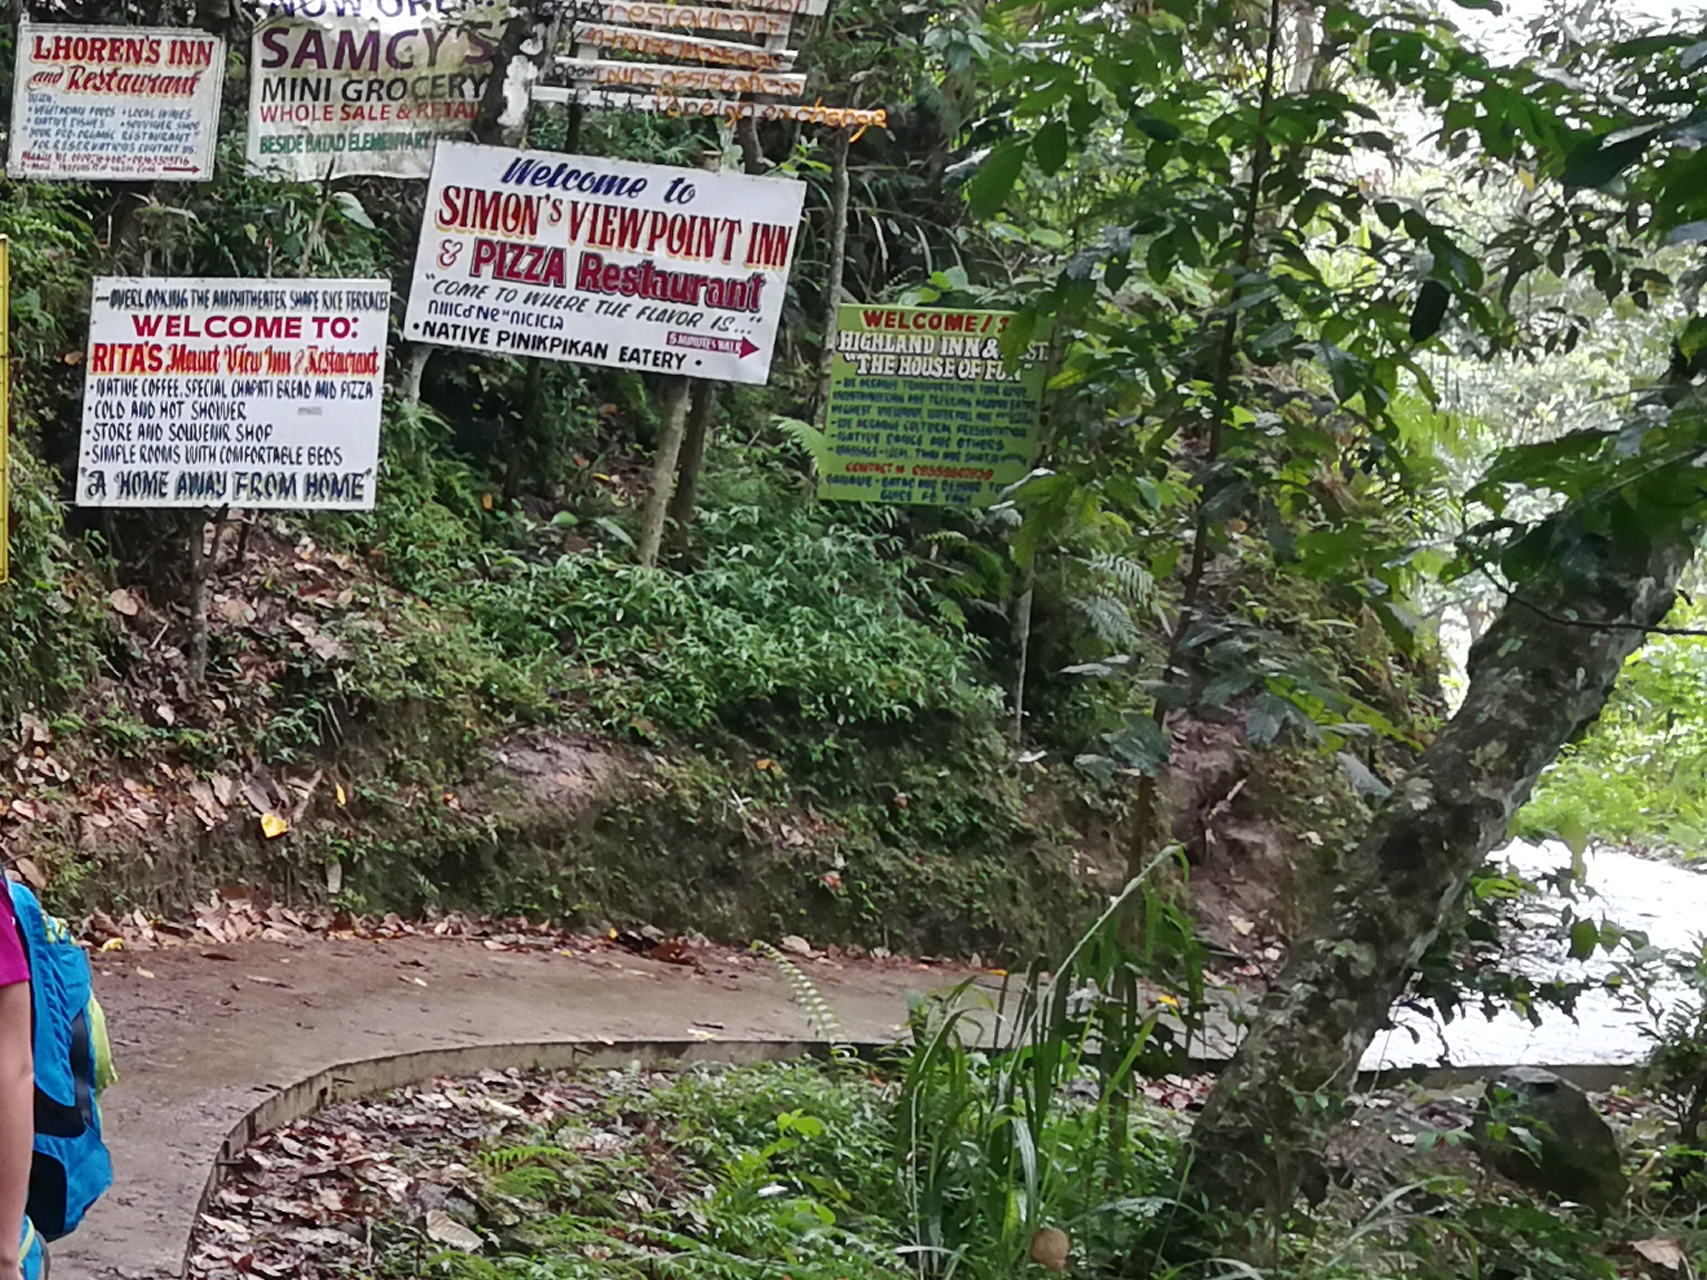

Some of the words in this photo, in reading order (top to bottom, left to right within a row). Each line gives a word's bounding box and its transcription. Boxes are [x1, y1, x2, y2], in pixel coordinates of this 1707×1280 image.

[33, 34, 161, 65] LHOREN'S
[169, 40, 214, 67] INN
[31, 69, 64, 85] and
[66, 65, 202, 96] Restaurant
[261, 77, 332, 102] MINI
[341, 74, 489, 102] GROCERY
[260, 104, 334, 123] WHOLE
[340, 104, 391, 121] SALE
[396, 104, 410, 120] &
[416, 100, 477, 120] RETAI
[501, 157, 647, 198] Welcome
[664, 177, 696, 204] to
[569, 200, 742, 262] VIEWPOINT
[745, 222, 793, 267] INN
[437, 239, 463, 268] &
[469, 237, 566, 288] PIZZA
[575, 251, 766, 312] Restaurant
[496, 288, 517, 303] TO
[523, 291, 590, 313] WHERE
[596, 300, 631, 318] THE
[636, 306, 703, 327] FLAVOR
[863, 310, 993, 333] WELCOME!
[132, 315, 302, 338] WELCOME
[312, 317, 358, 338] TO:
[92, 341, 163, 374] RITA'S
[224, 343, 263, 374] View
[265, 345, 291, 374] Inn
[423, 321, 490, 344] NATIVE
[497, 330, 608, 360] PINIKPIKAN
[619, 347, 687, 369] EATERY
[838, 330, 936, 355] HIGHLAND
[939, 335, 981, 357] INN
[982, 339, 998, 360] &
[899, 356, 955, 378] HOUSE
[958, 359, 983, 379] OF
[96, 378, 137, 397] NATIVE
[186, 378, 226, 397] SPECIAL
[231, 379, 274, 398] CHAPATI
[277, 380, 311, 399] BREAD
[315, 381, 337, 399] AND
[341, 381, 373, 399] PIZZA
